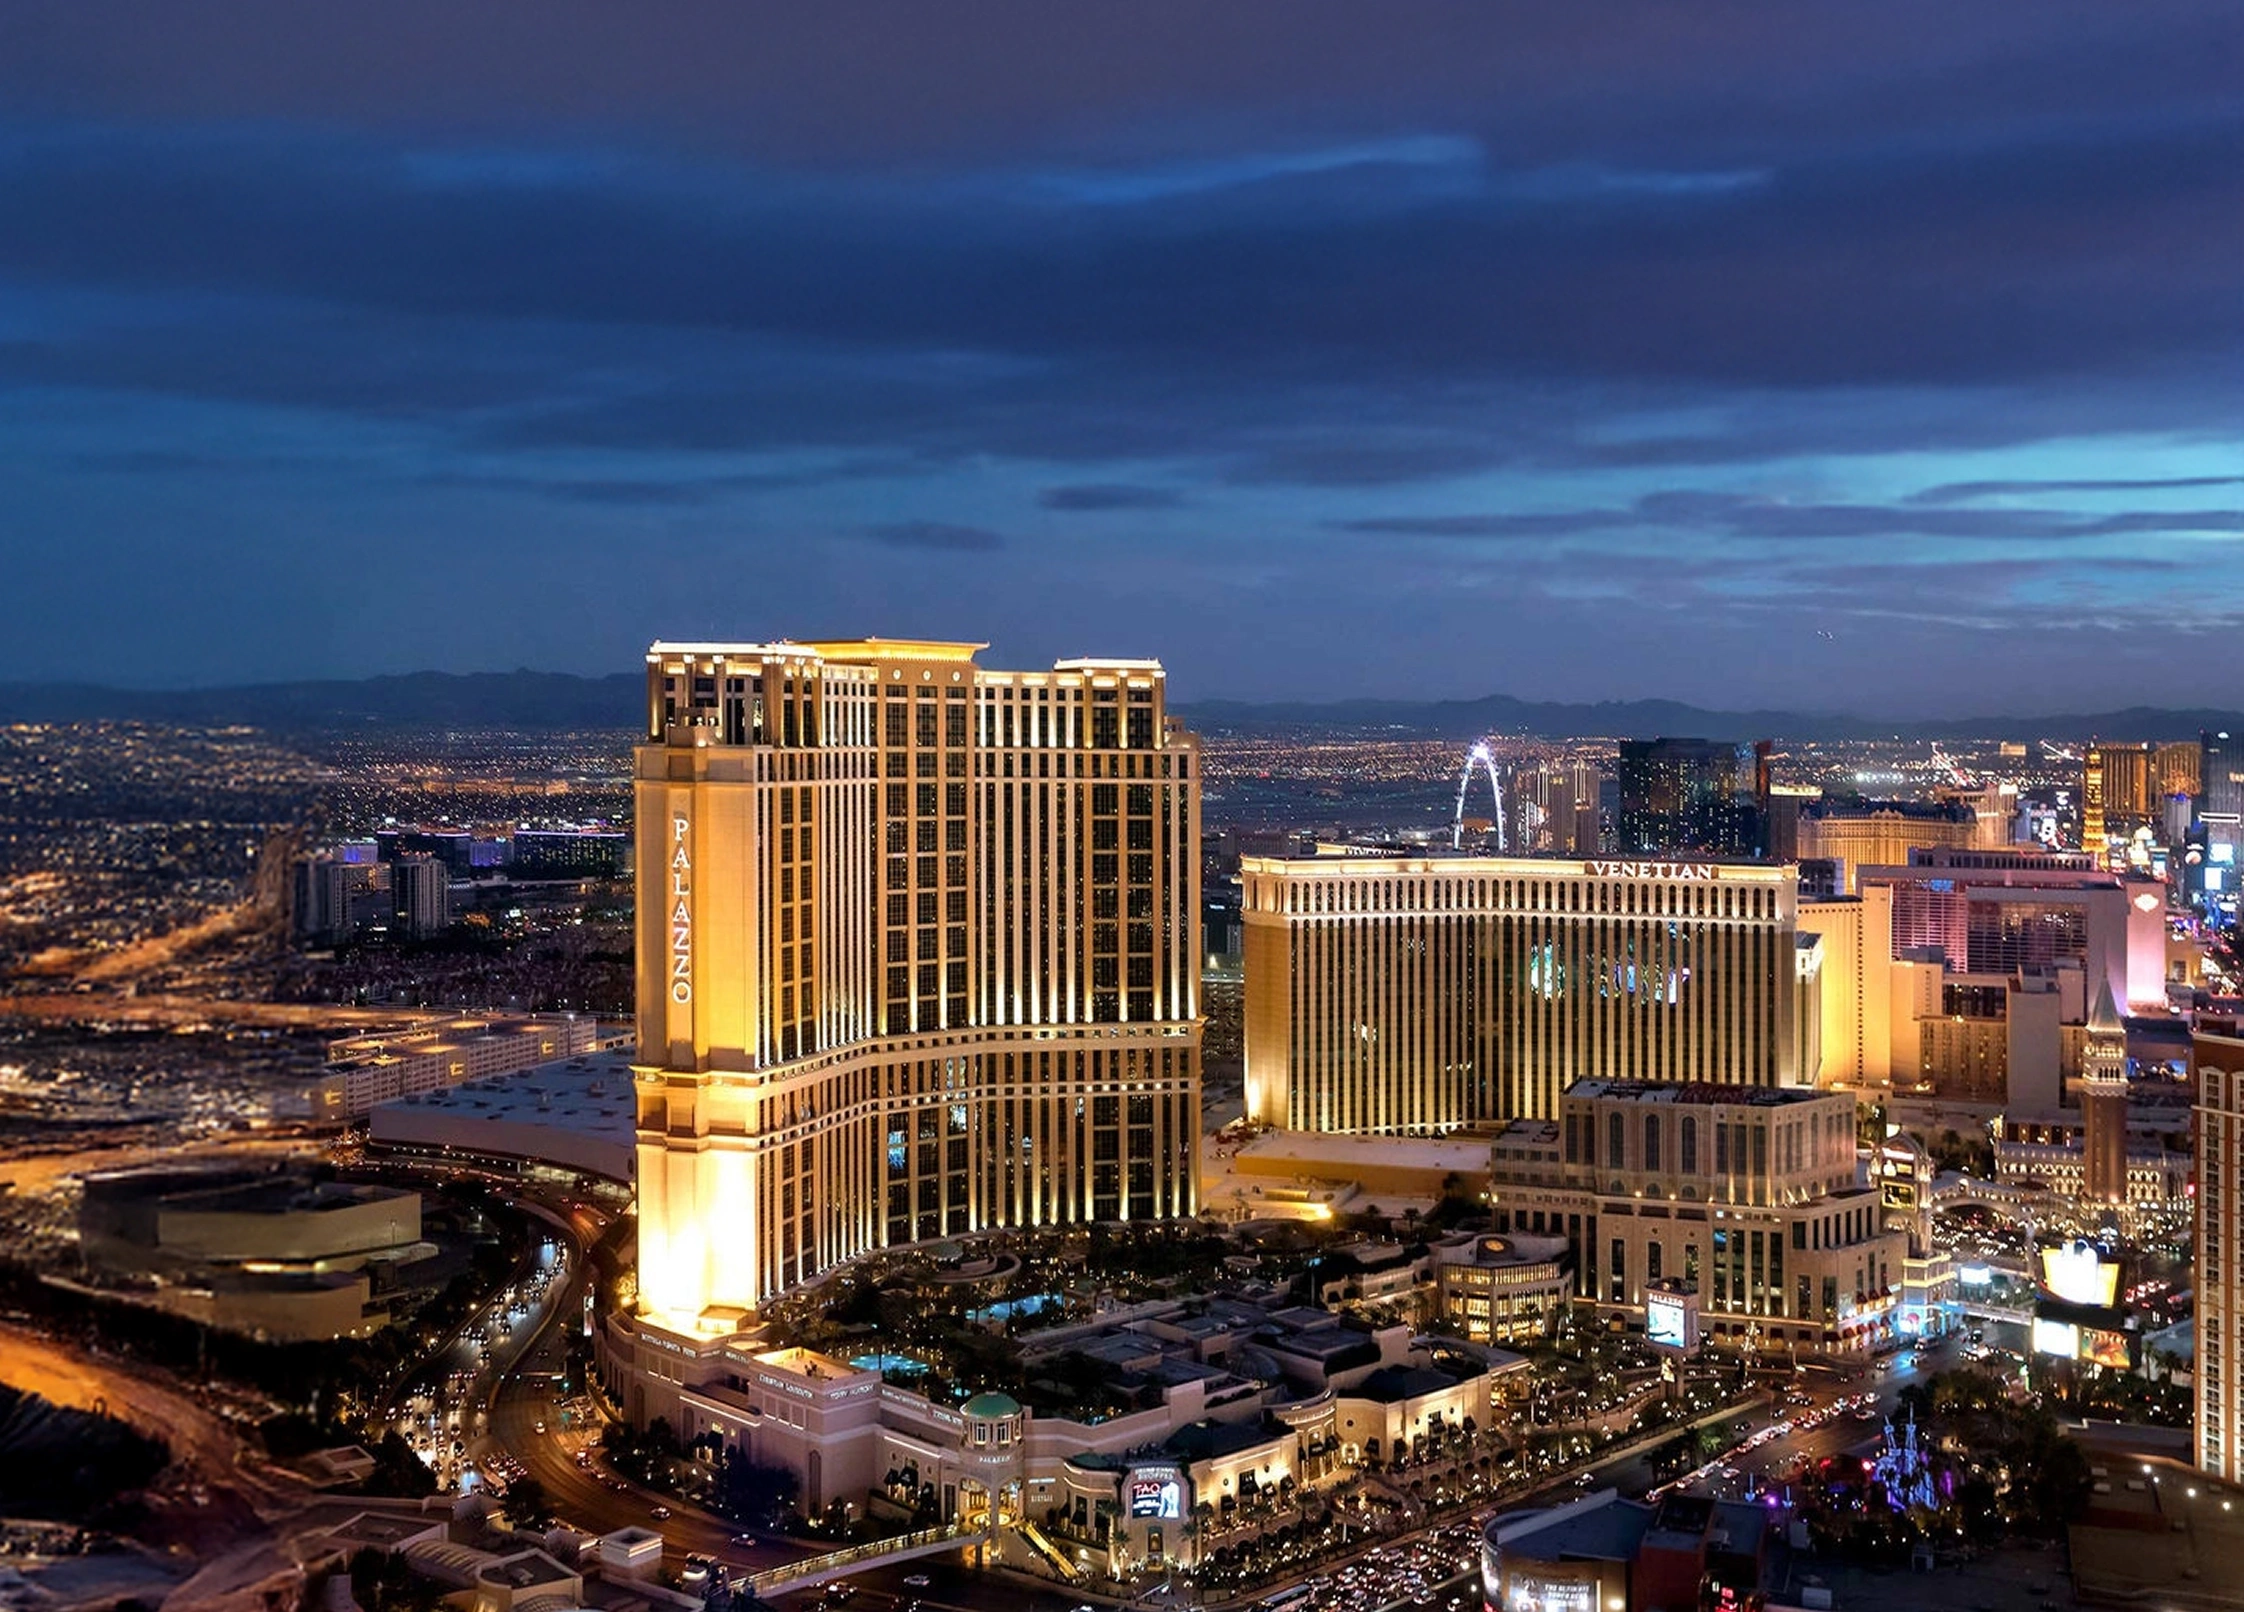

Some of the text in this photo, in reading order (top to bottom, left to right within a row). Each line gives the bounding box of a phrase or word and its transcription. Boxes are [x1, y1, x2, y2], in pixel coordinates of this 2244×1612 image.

[1591, 860, 1713, 880] VENETIAN
[672, 818, 692, 1004] PALAZZO
[1133, 1482, 1161, 1497] TAO
